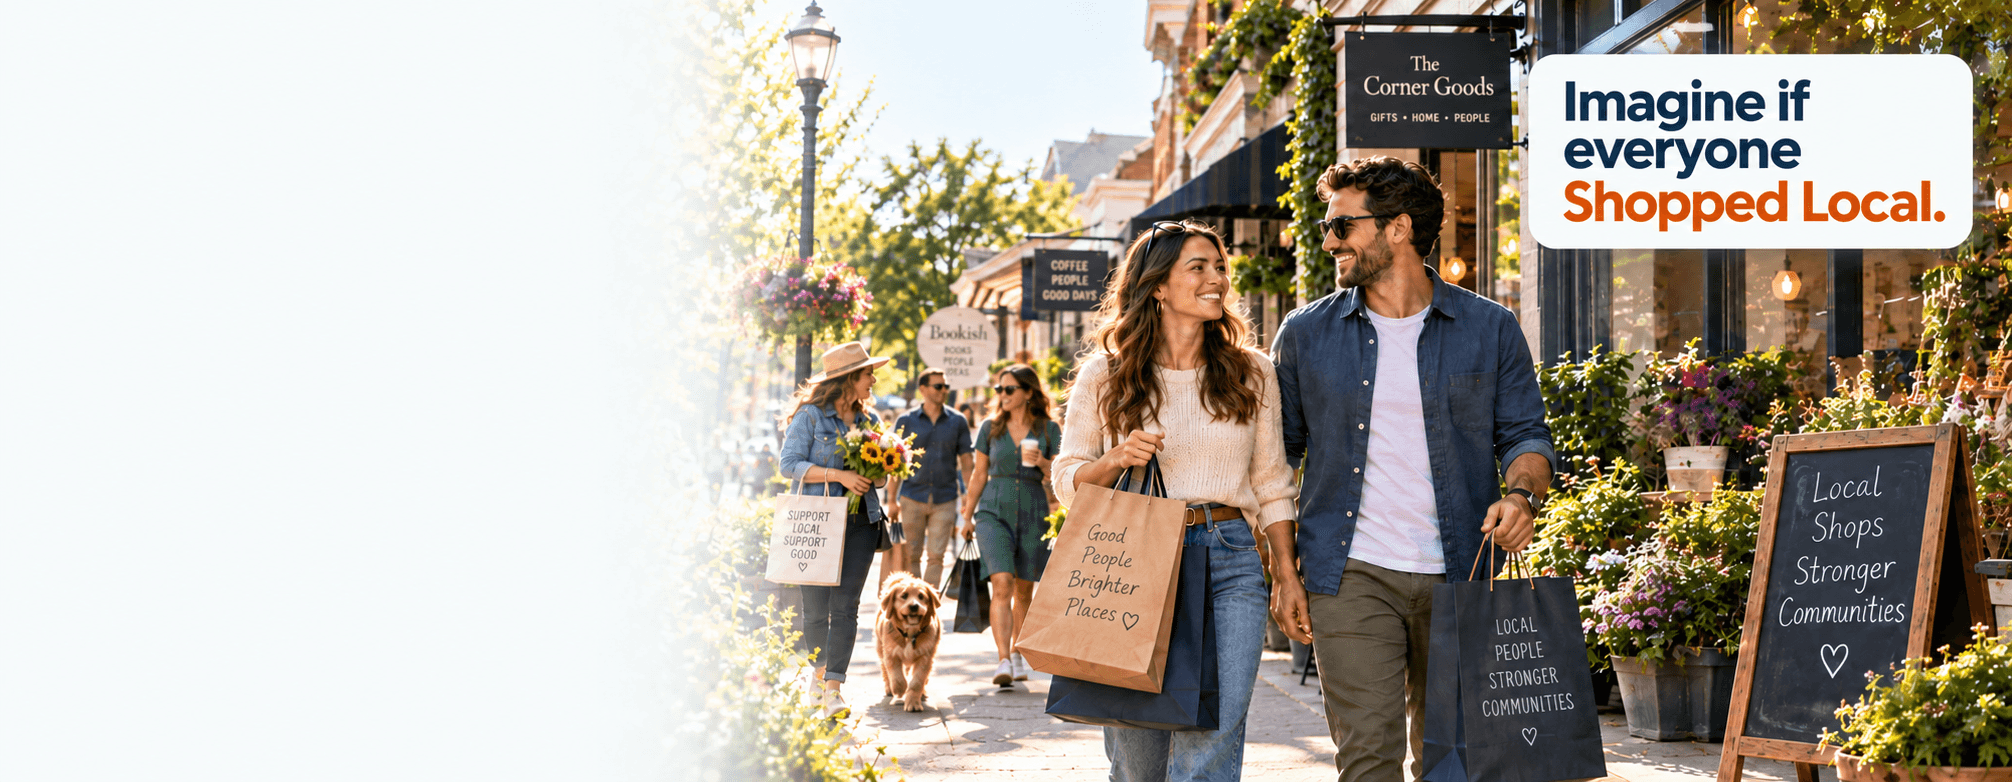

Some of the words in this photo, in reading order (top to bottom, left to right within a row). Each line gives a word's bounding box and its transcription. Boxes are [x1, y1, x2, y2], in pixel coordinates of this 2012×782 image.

[1410, 55, 1439, 71] The
[1364, 76, 1429, 95] Corner
[1434, 76, 1493, 95] Goods
[1371, 113, 1397, 122] GIFTS
[1412, 113, 1439, 122] HOME
[1455, 114, 1489, 122] PEOPLE
[1051, 260, 1089, 271] COFFEE
[1052, 275, 1088, 285] PEOPLE
[1043, 290, 1070, 300] GOOD
[1073, 291, 1097, 300] DAYS
[930, 324, 988, 340] Bookish
[1813, 465, 1882, 502] Local
[788, 510, 830, 523] SUPPORT
[792, 523, 822, 535] LOCAL
[1087, 523, 1128, 544] Good
[1812, 512, 1883, 548] Shops
[785, 536, 828, 548] SUPPORT
[791, 549, 817, 559] GOOD
[1082, 546, 1133, 570] People
[1068, 569, 1141, 596] Brighter
[1794, 556, 1896, 593] Stronger
[1065, 597, 1118, 623] Places
[1779, 596, 1905, 626] Communities
[1496, 617, 1537, 635] LOCAL
[1495, 641, 1544, 661] PEOPLE
[1489, 667, 1558, 689] STRONGER
[1483, 693, 1574, 717] COMMUNITIES
